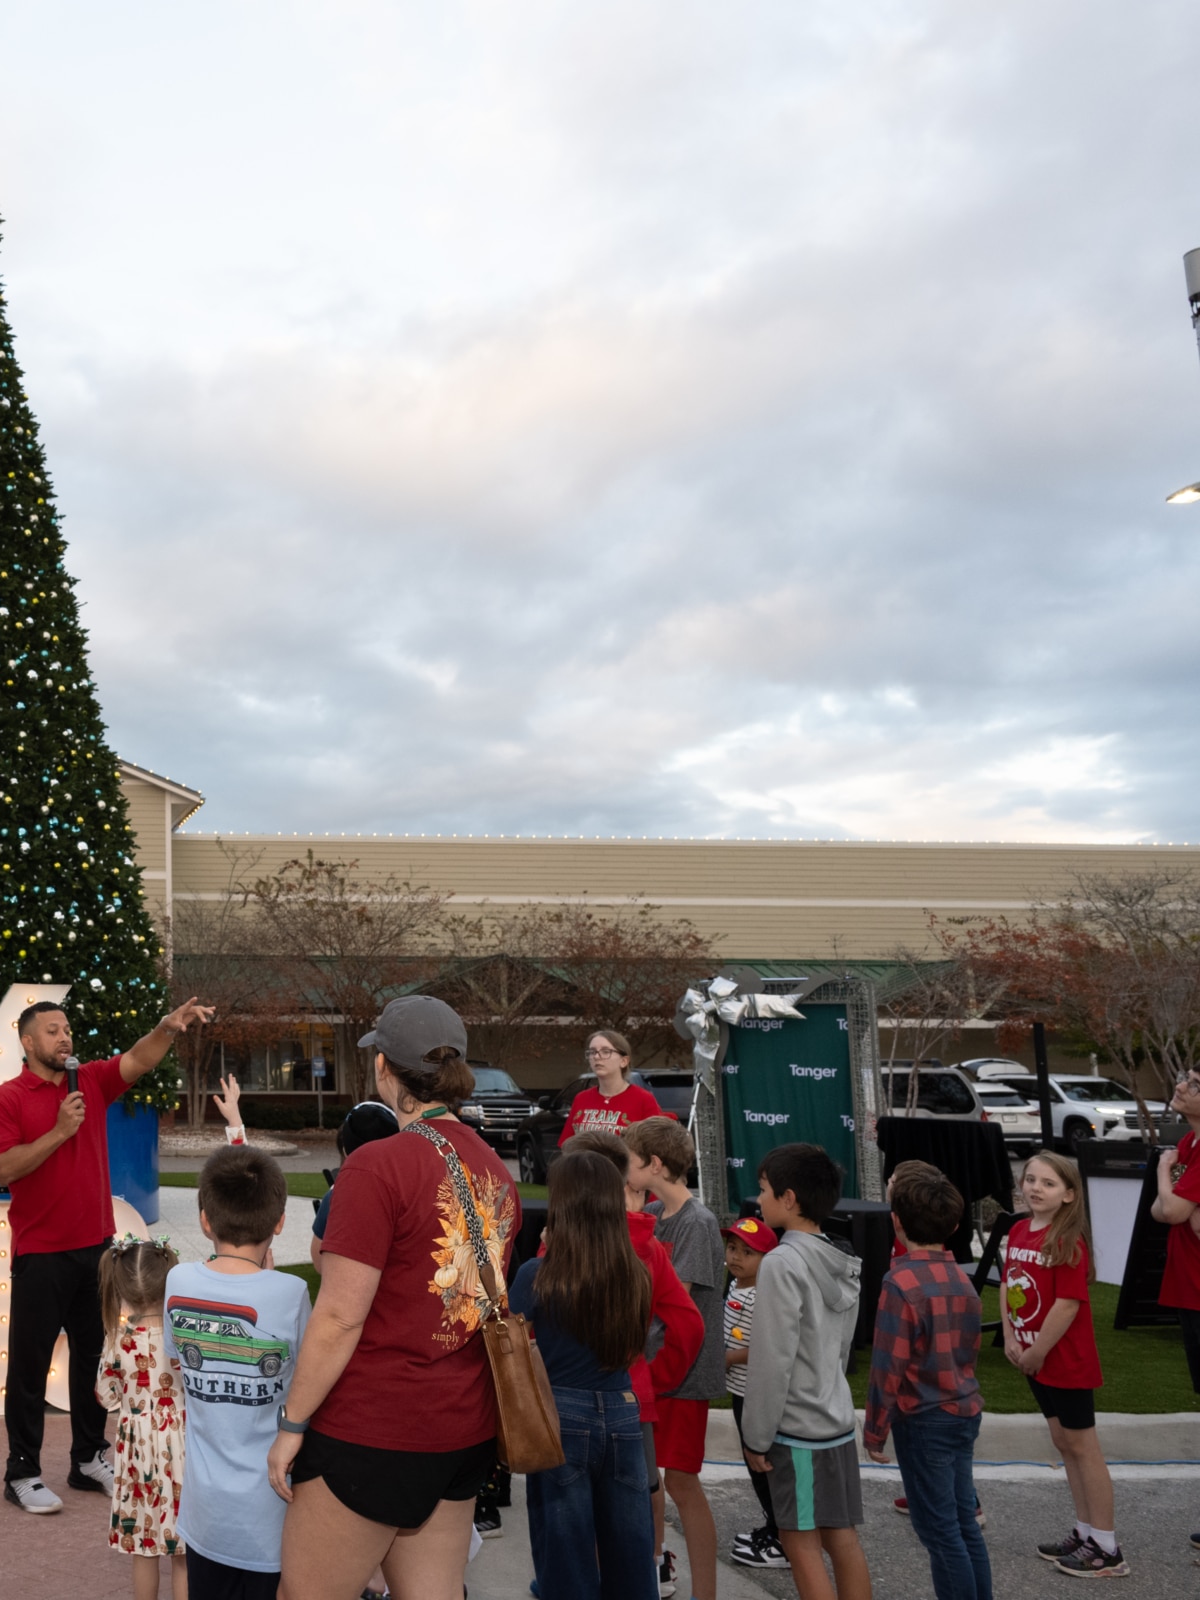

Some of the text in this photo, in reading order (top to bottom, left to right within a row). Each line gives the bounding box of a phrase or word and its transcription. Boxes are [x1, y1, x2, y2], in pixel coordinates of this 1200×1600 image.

[789, 1064, 837, 1080] Tanger
[582, 1109, 621, 1124] TEAM
[743, 1109, 790, 1126] Tanger
[431, 1331, 460, 1347] simply
[183, 1373, 284, 1397] OUTHERN
[192, 1391, 272, 1406] ACATION
